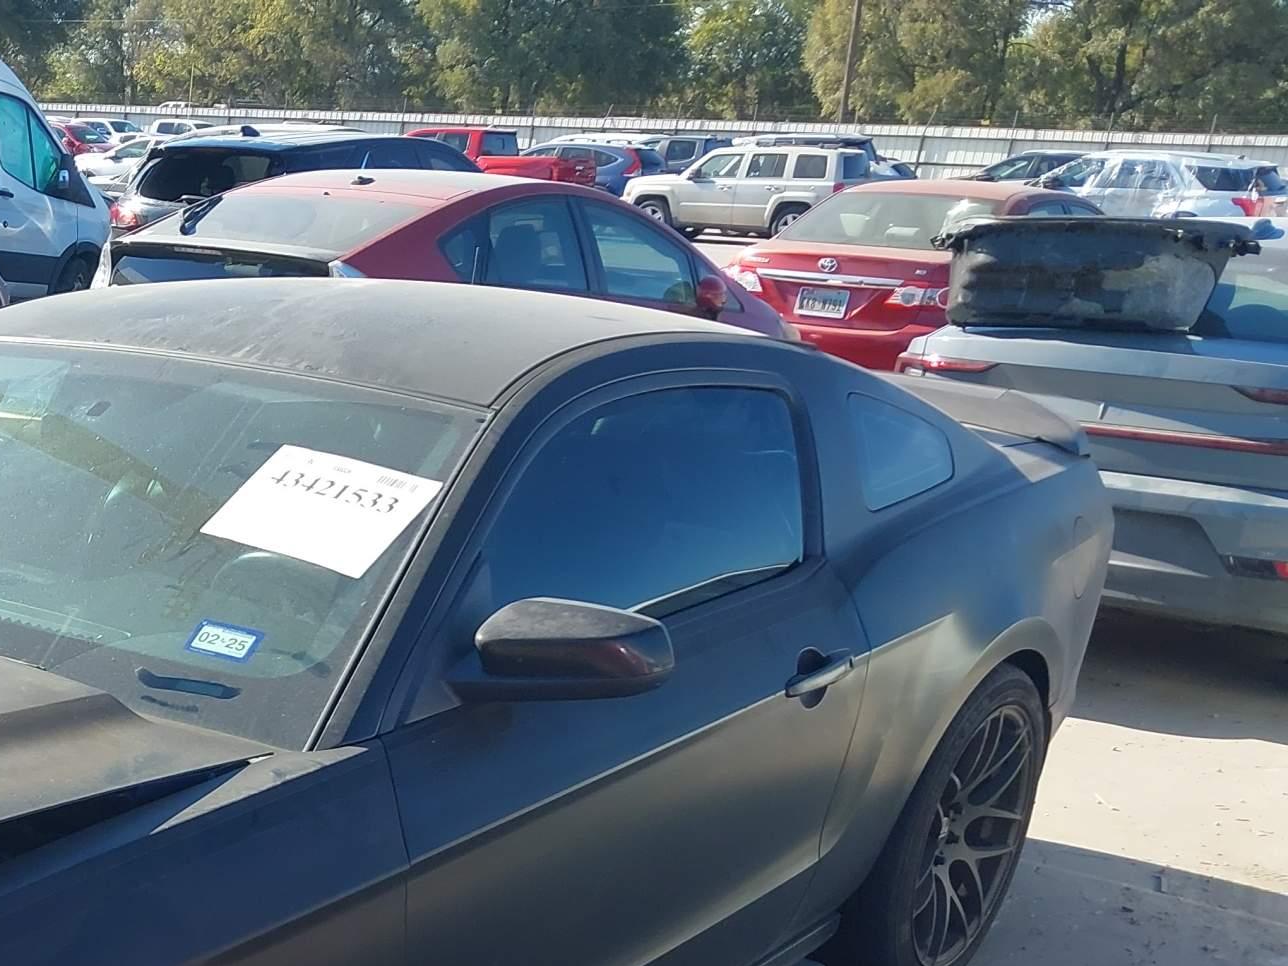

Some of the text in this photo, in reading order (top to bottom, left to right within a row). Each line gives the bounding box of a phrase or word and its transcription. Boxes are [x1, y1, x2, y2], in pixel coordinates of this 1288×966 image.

[271, 469, 399, 513] 43421533
[198, 631, 249, 652] 02 25
